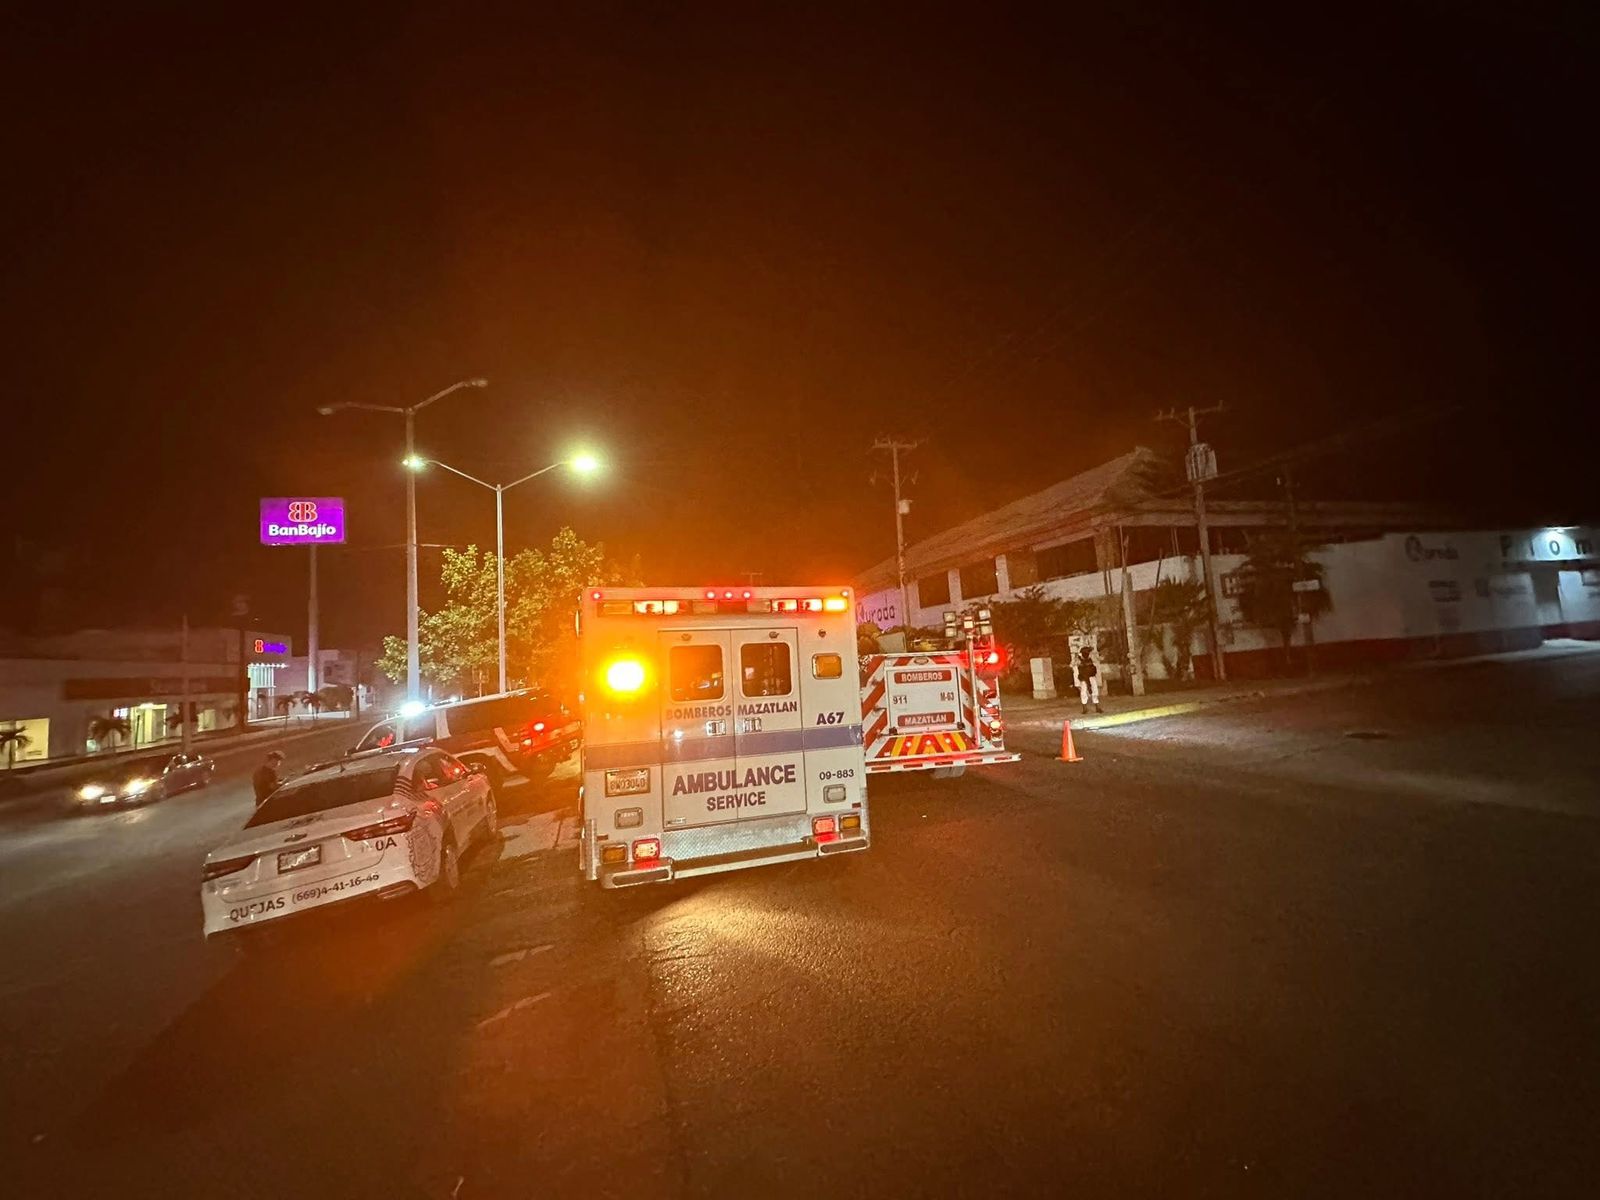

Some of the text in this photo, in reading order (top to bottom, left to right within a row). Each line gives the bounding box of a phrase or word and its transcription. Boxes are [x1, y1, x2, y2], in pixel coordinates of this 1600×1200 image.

[268, 523, 337, 538] BanBajío
[900, 671, 944, 682] BOMBEROS
[893, 695, 908, 704] 911
[665, 701, 798, 720] BOMBEROS MAZATLAN
[816, 711, 845, 726] A67
[672, 764, 796, 796] AMBULANCE
[818, 768, 855, 781] 09-883
[706, 791, 766, 812] SERVICE
